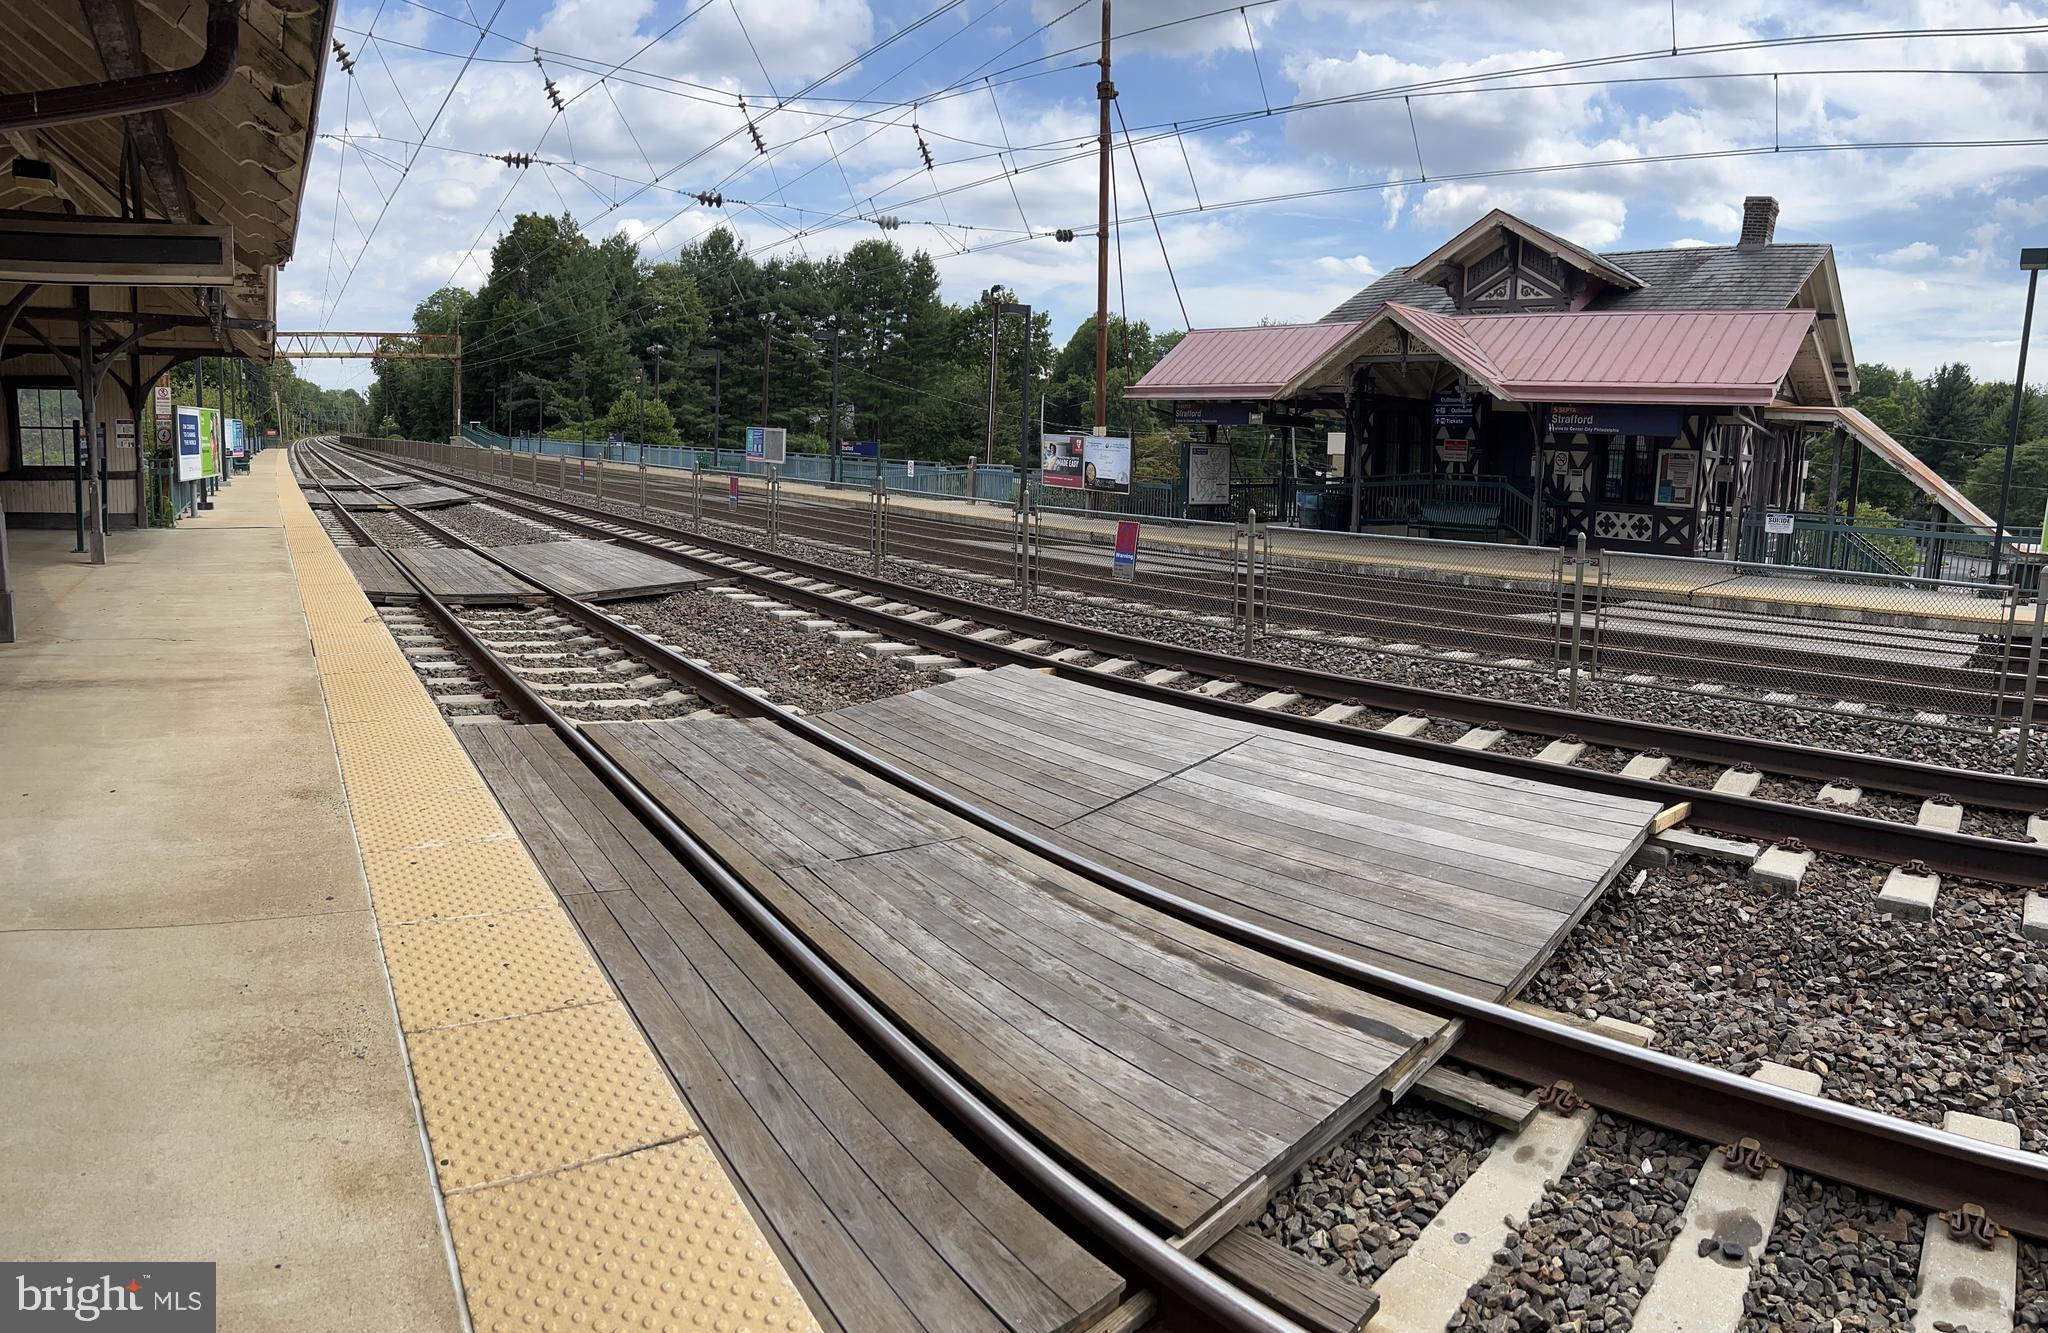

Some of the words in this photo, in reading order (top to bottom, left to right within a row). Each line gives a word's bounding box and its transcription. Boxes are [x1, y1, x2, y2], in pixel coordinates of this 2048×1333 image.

[1551, 414, 1593, 424] Strafford
[1069, 460, 1080, 468] EASY
[1115, 552, 1134, 561] Warning
